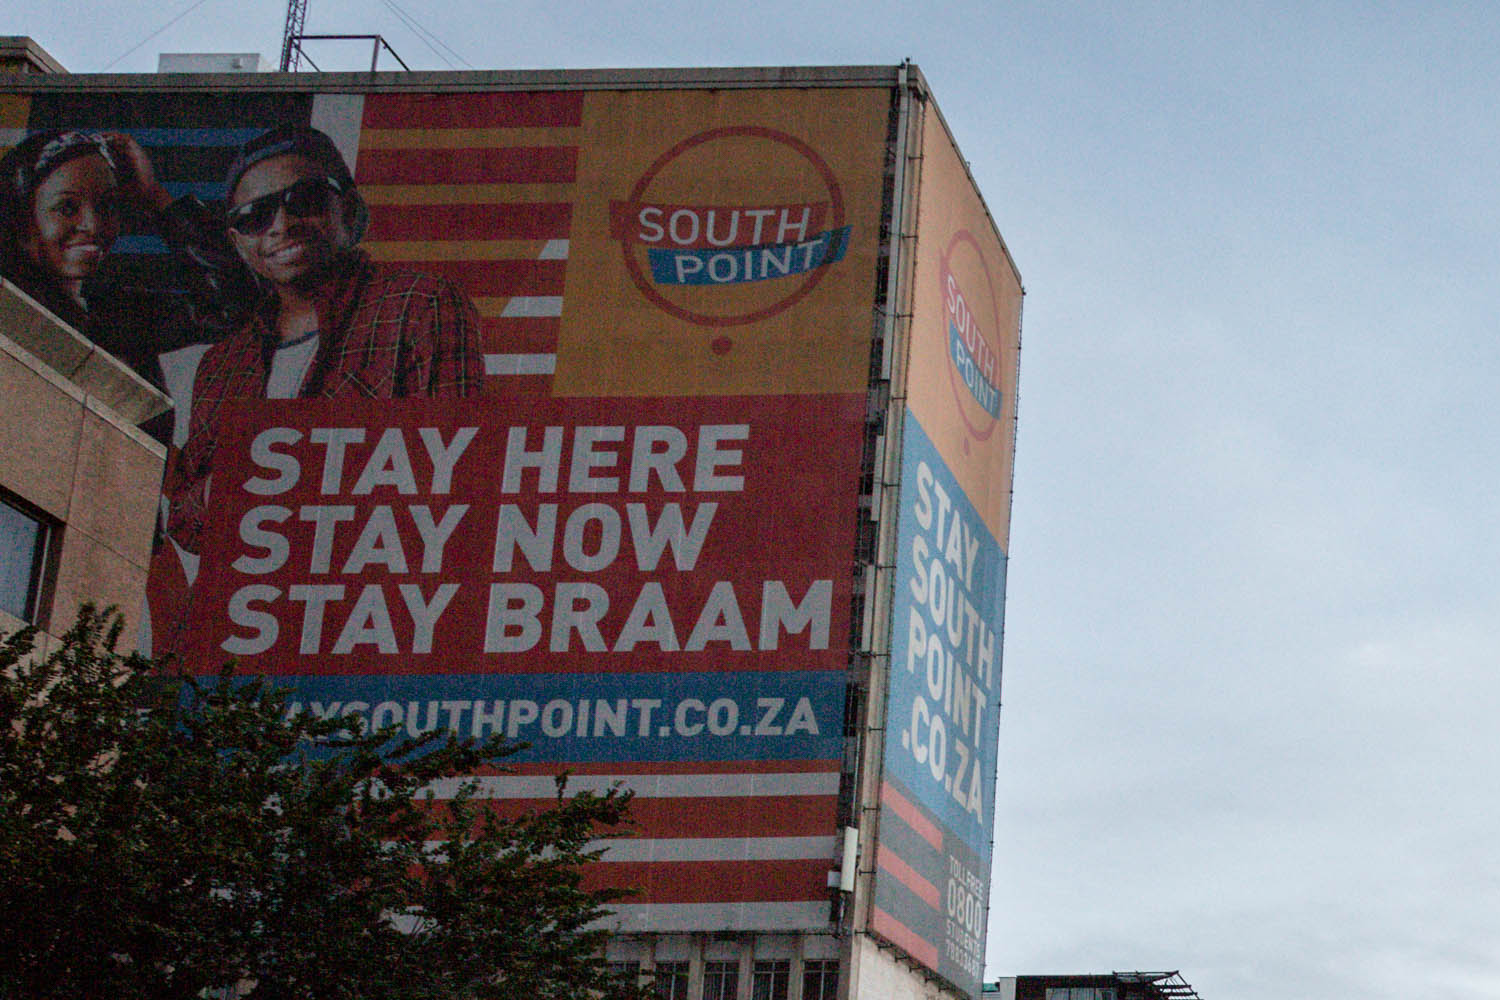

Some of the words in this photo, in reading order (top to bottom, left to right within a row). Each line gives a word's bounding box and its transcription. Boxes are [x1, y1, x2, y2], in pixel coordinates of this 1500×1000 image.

[639, 205, 811, 247] SOUTH
[675, 234, 823, 285] POINT
[946, 273, 995, 384] SOUTH
[956, 338, 998, 412] POINT
[244, 425, 478, 496] STAY
[502, 423, 751, 493] HERE
[232, 504, 469, 574] STAY
[493, 502, 719, 573] NOW
[914, 461, 980, 593] STAY
[221, 583, 460, 655] STAY
[484, 580, 833, 653] BRAAM
[910, 534, 995, 690] SOUTH
[907, 605, 986, 748] POINT
[902, 696, 983, 825] .CO.ZA
[947, 877, 982, 939] 0800
